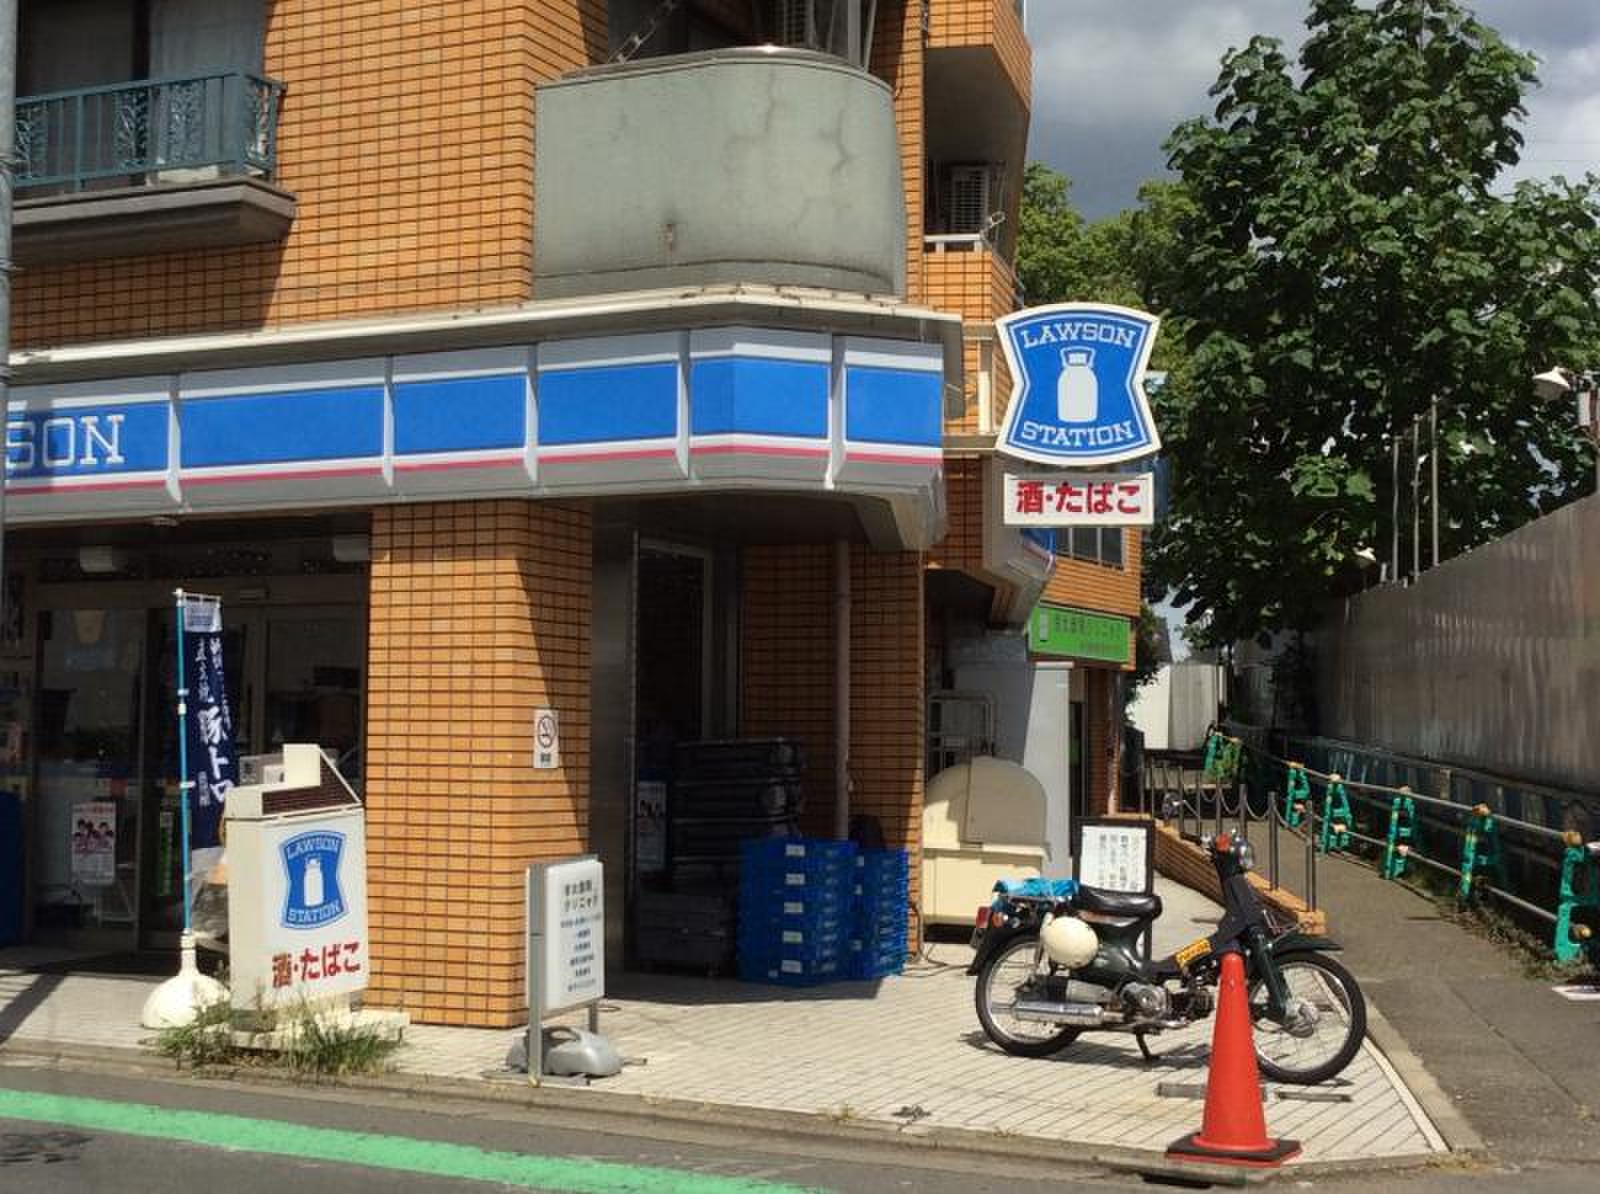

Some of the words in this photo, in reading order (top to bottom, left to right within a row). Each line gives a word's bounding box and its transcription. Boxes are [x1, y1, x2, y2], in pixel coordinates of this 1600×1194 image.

[1021, 322, 1136, 348] LAWSON
[1021, 420, 1134, 447] STATION
[1016, 480, 1141, 514] 酒・たばこ
[288, 835, 340, 860] LAWSON
[288, 899, 344, 923] STATION
[271, 941, 361, 989] 酒・たばこ
